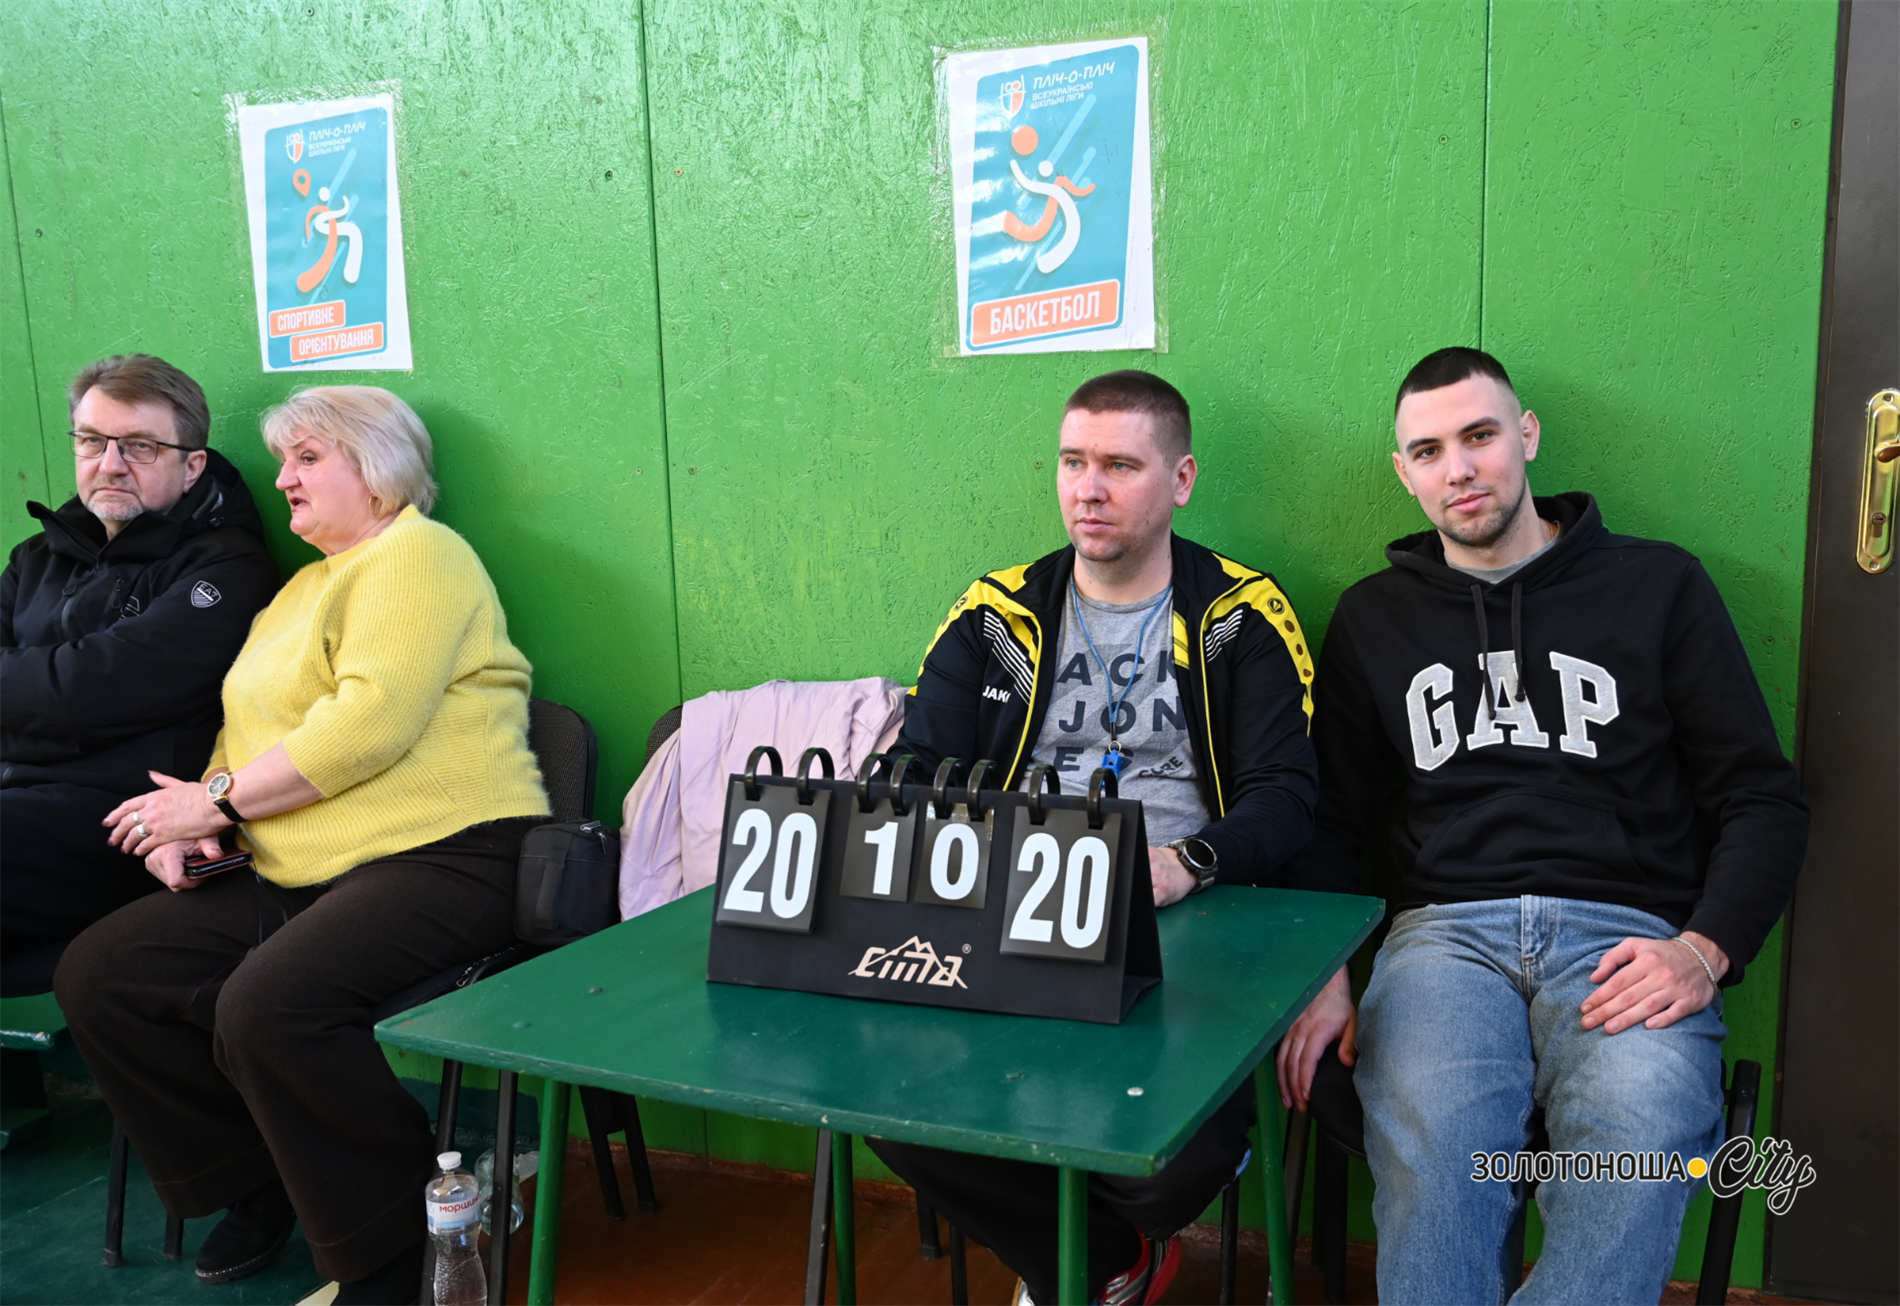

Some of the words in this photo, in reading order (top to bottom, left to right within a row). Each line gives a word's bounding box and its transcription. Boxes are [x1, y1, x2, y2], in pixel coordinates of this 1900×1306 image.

[1033, 61, 1115, 90] ПЛІЧ-О-ПЛІЧ
[1031, 96, 1065, 110] ШКІЛЬНІ
[1066, 92, 1084, 103] ЛІГИ
[1032, 81, 1093, 101] ВСЕУКРАЇНСЬКІ
[309, 121, 366, 141] ПЛІЧ-О-ПЛІЧ
[277, 306, 335, 331] СПОРТИВНЕ
[990, 290, 1100, 335] БАСКЕТБОЛ
[299, 328, 374, 356] ОРІЄНТУВАННЯ
[982, 685, 1011, 703] JAK
[1058, 698, 1187, 735] JON
[1406, 650, 1619, 771] GAP
[723, 808, 818, 919] 20
[864, 821, 899, 895] 1
[930, 823, 979, 900] 0
[1009, 833, 1110, 949] 20
